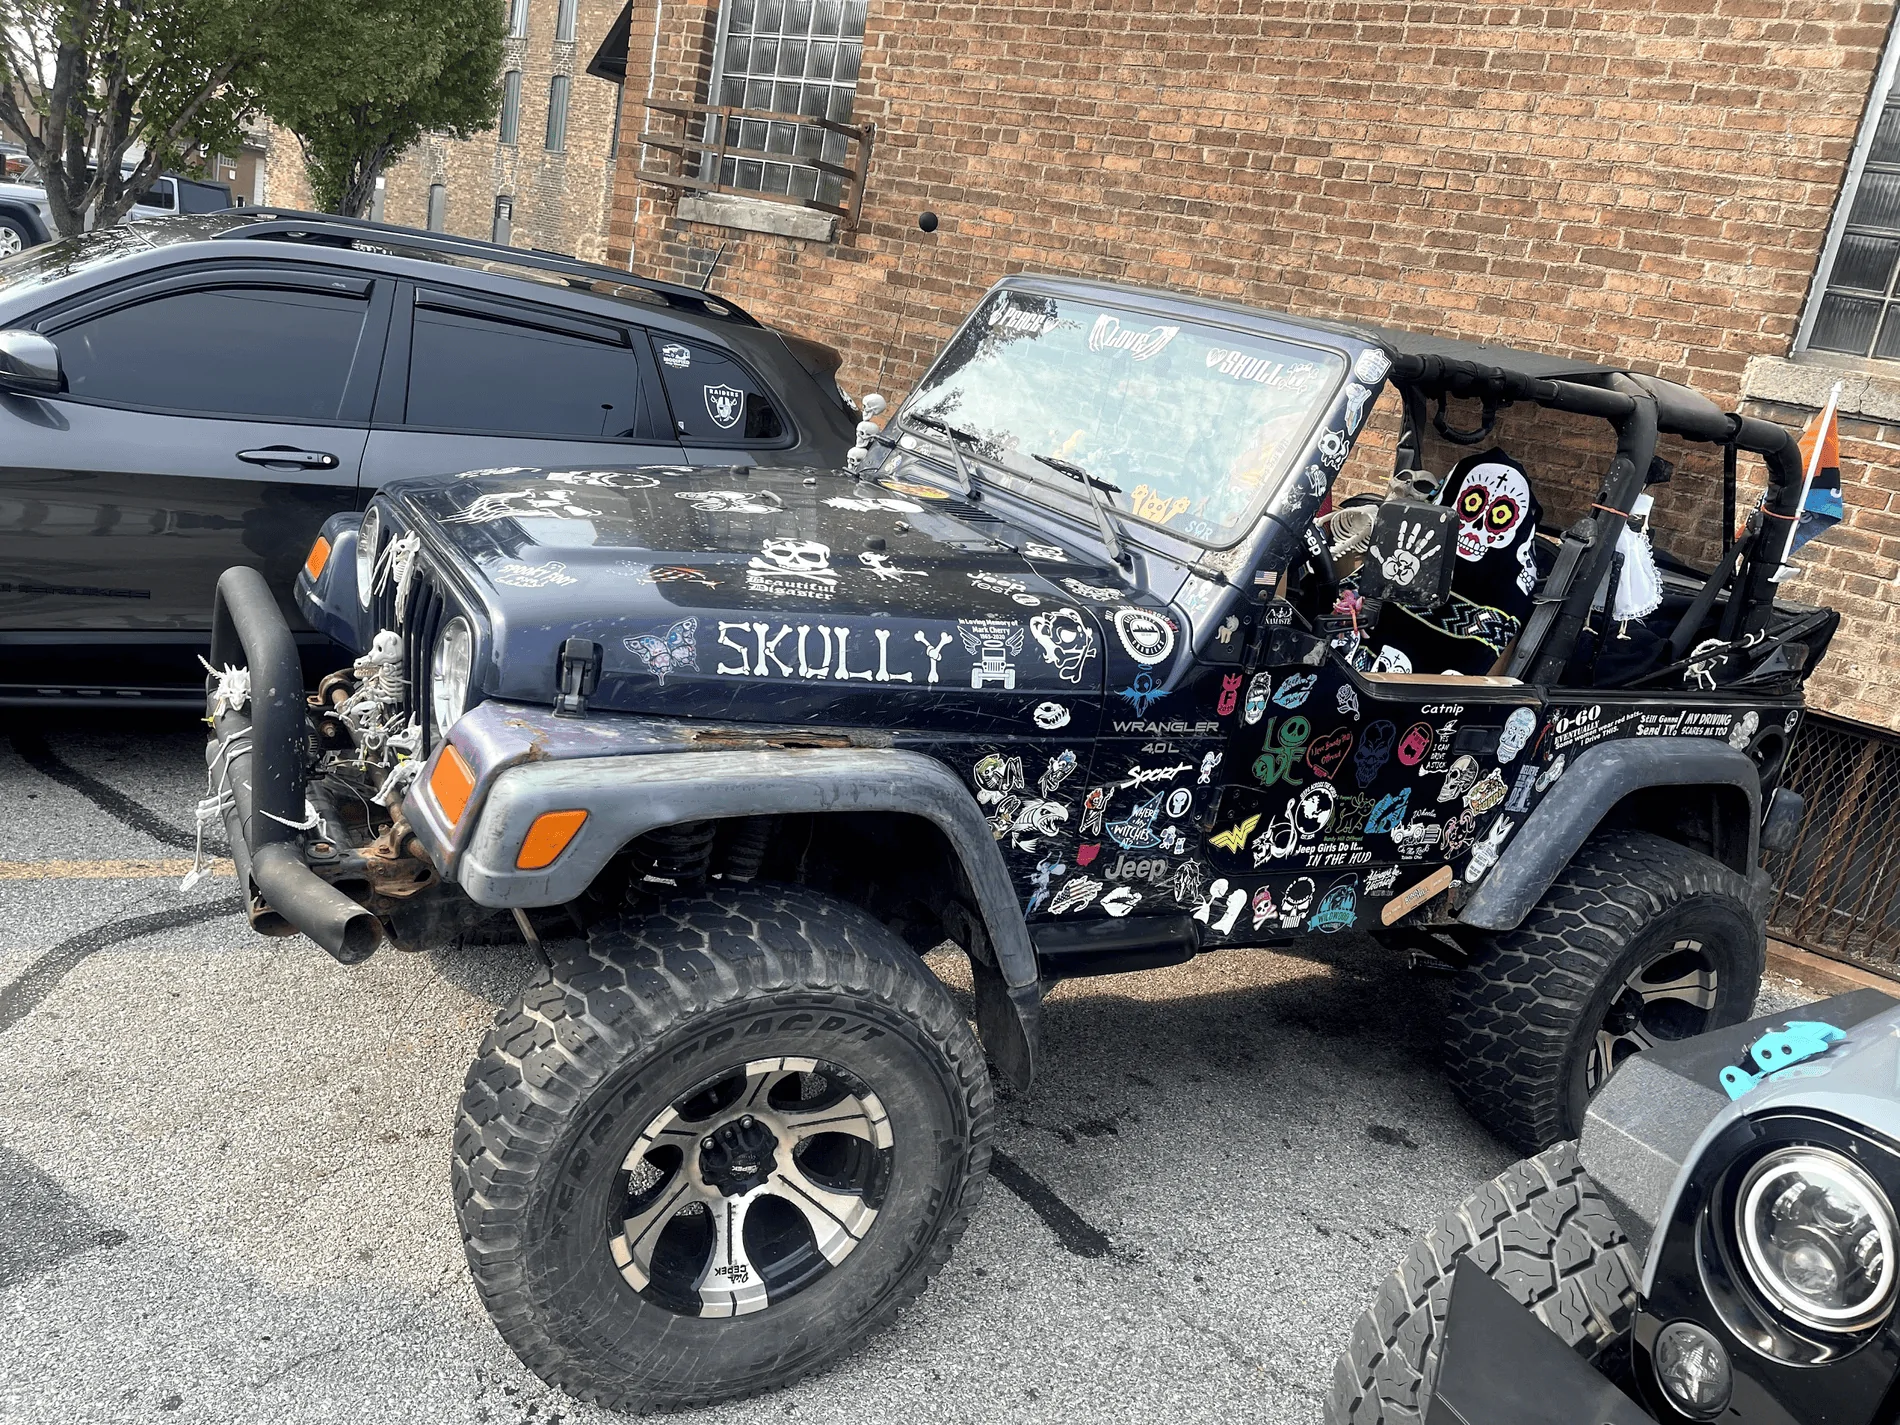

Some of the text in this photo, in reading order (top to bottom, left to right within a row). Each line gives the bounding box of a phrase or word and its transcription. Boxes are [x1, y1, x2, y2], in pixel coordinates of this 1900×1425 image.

[998, 307, 1047, 332] PEACE
[1103, 325, 1151, 352] LOVE
[1219, 351, 1284, 386] SKULL
[709, 388, 738, 398] RAIDERS
[745, 576, 836, 593] Beautiful
[748, 584, 833, 600] Disaster
[986, 619, 1010, 627] Memory
[989, 626, 1010, 636] Cherry
[717, 620, 952, 683] SKULLY
[1224, 690, 1234, 704] F
[1421, 704, 1464, 716] Catnip
[1556, 704, 1602, 734] 0-60
[1640, 715, 1679, 723] Still Gonna
[1684, 713, 1732, 726] MY DRIVING
[1113, 722, 1220, 732] WRANGLER
[1554, 720, 1600, 745] EVENTUALLY
[1555, 739, 1573, 750] Some
[1574, 729, 1597, 742] women
[1598, 722, 1614, 732] wear
[1614, 716, 1625, 725] red
[1636, 724, 1662, 736] Send
[1681, 726, 1728, 736] SCARES ME TOO
[1584, 734, 1601, 744] Drive
[1602, 726, 1619, 737] THIS.
[1132, 806, 1160, 820] WHERE
[1114, 825, 1152, 841] WITCHES
[1296, 844, 1316, 855] Jeep
[1317, 843, 1336, 852] Girls
[1338, 843, 1349, 851] Do
[1306, 854, 1323, 867] IN
[1324, 853, 1347, 866] THE
[1105, 856, 1166, 881] Jeep
[714, 1265, 748, 1276] CEPEK
